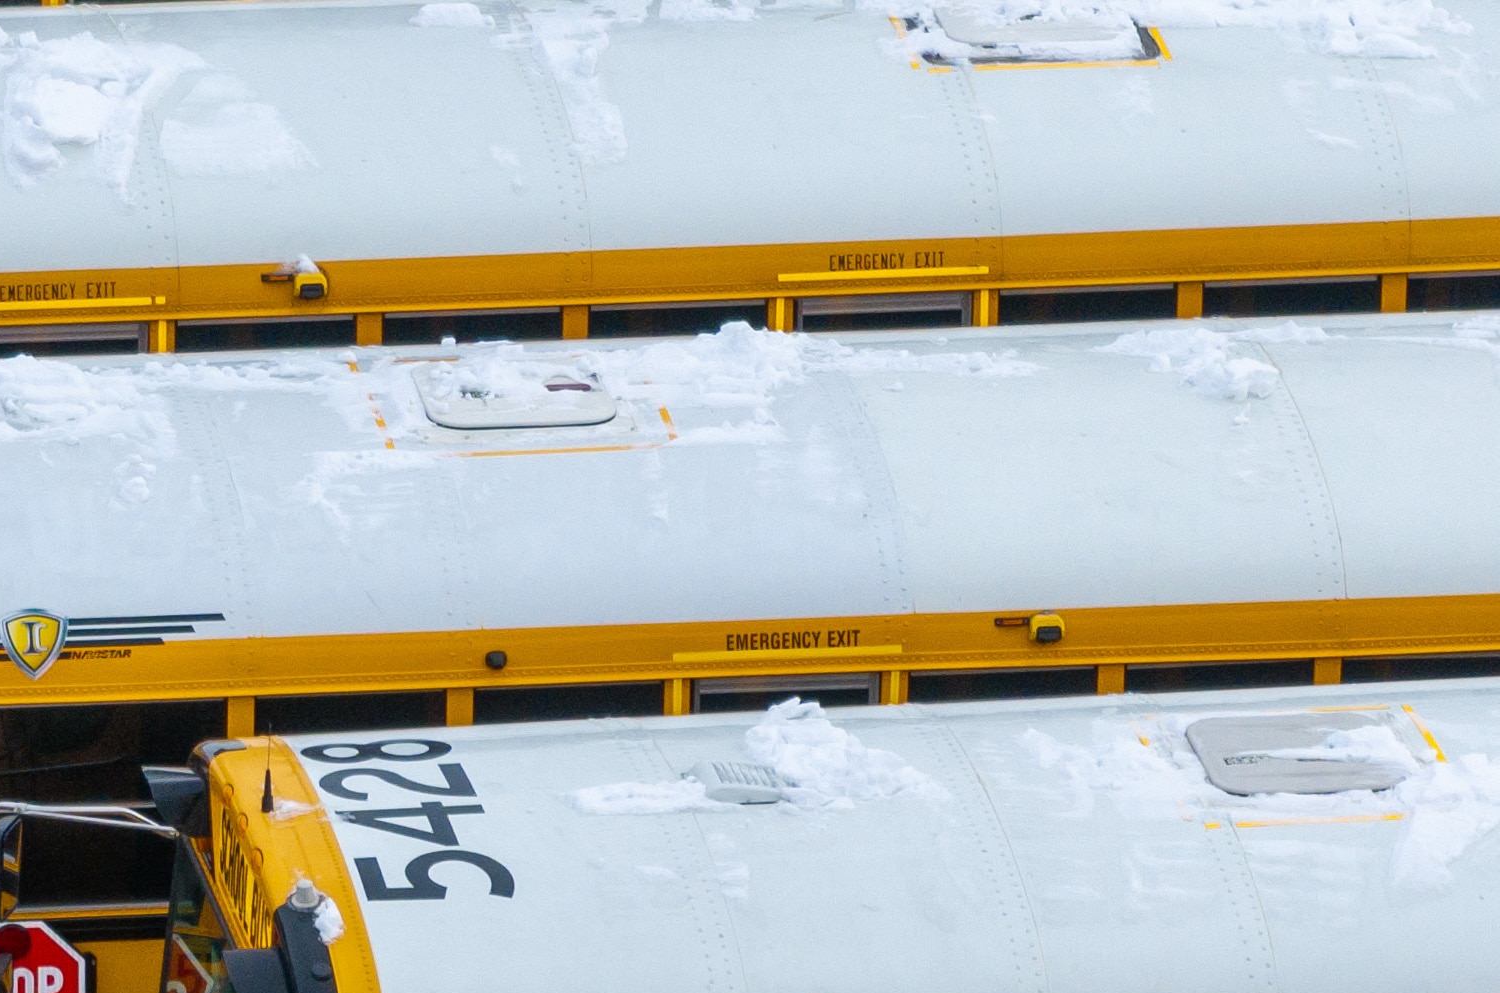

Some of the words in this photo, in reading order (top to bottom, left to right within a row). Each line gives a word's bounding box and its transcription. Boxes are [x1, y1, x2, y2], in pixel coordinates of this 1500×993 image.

[829, 252, 905, 271] EMERGENCY
[915, 251, 945, 268] EXIT
[0, 283, 76, 302] EMERGENCY
[86, 281, 117, 299] EXIT
[726, 631, 821, 651] EMERGENCY
[827, 629, 861, 648] EXIT
[300, 738, 515, 901] 5428
